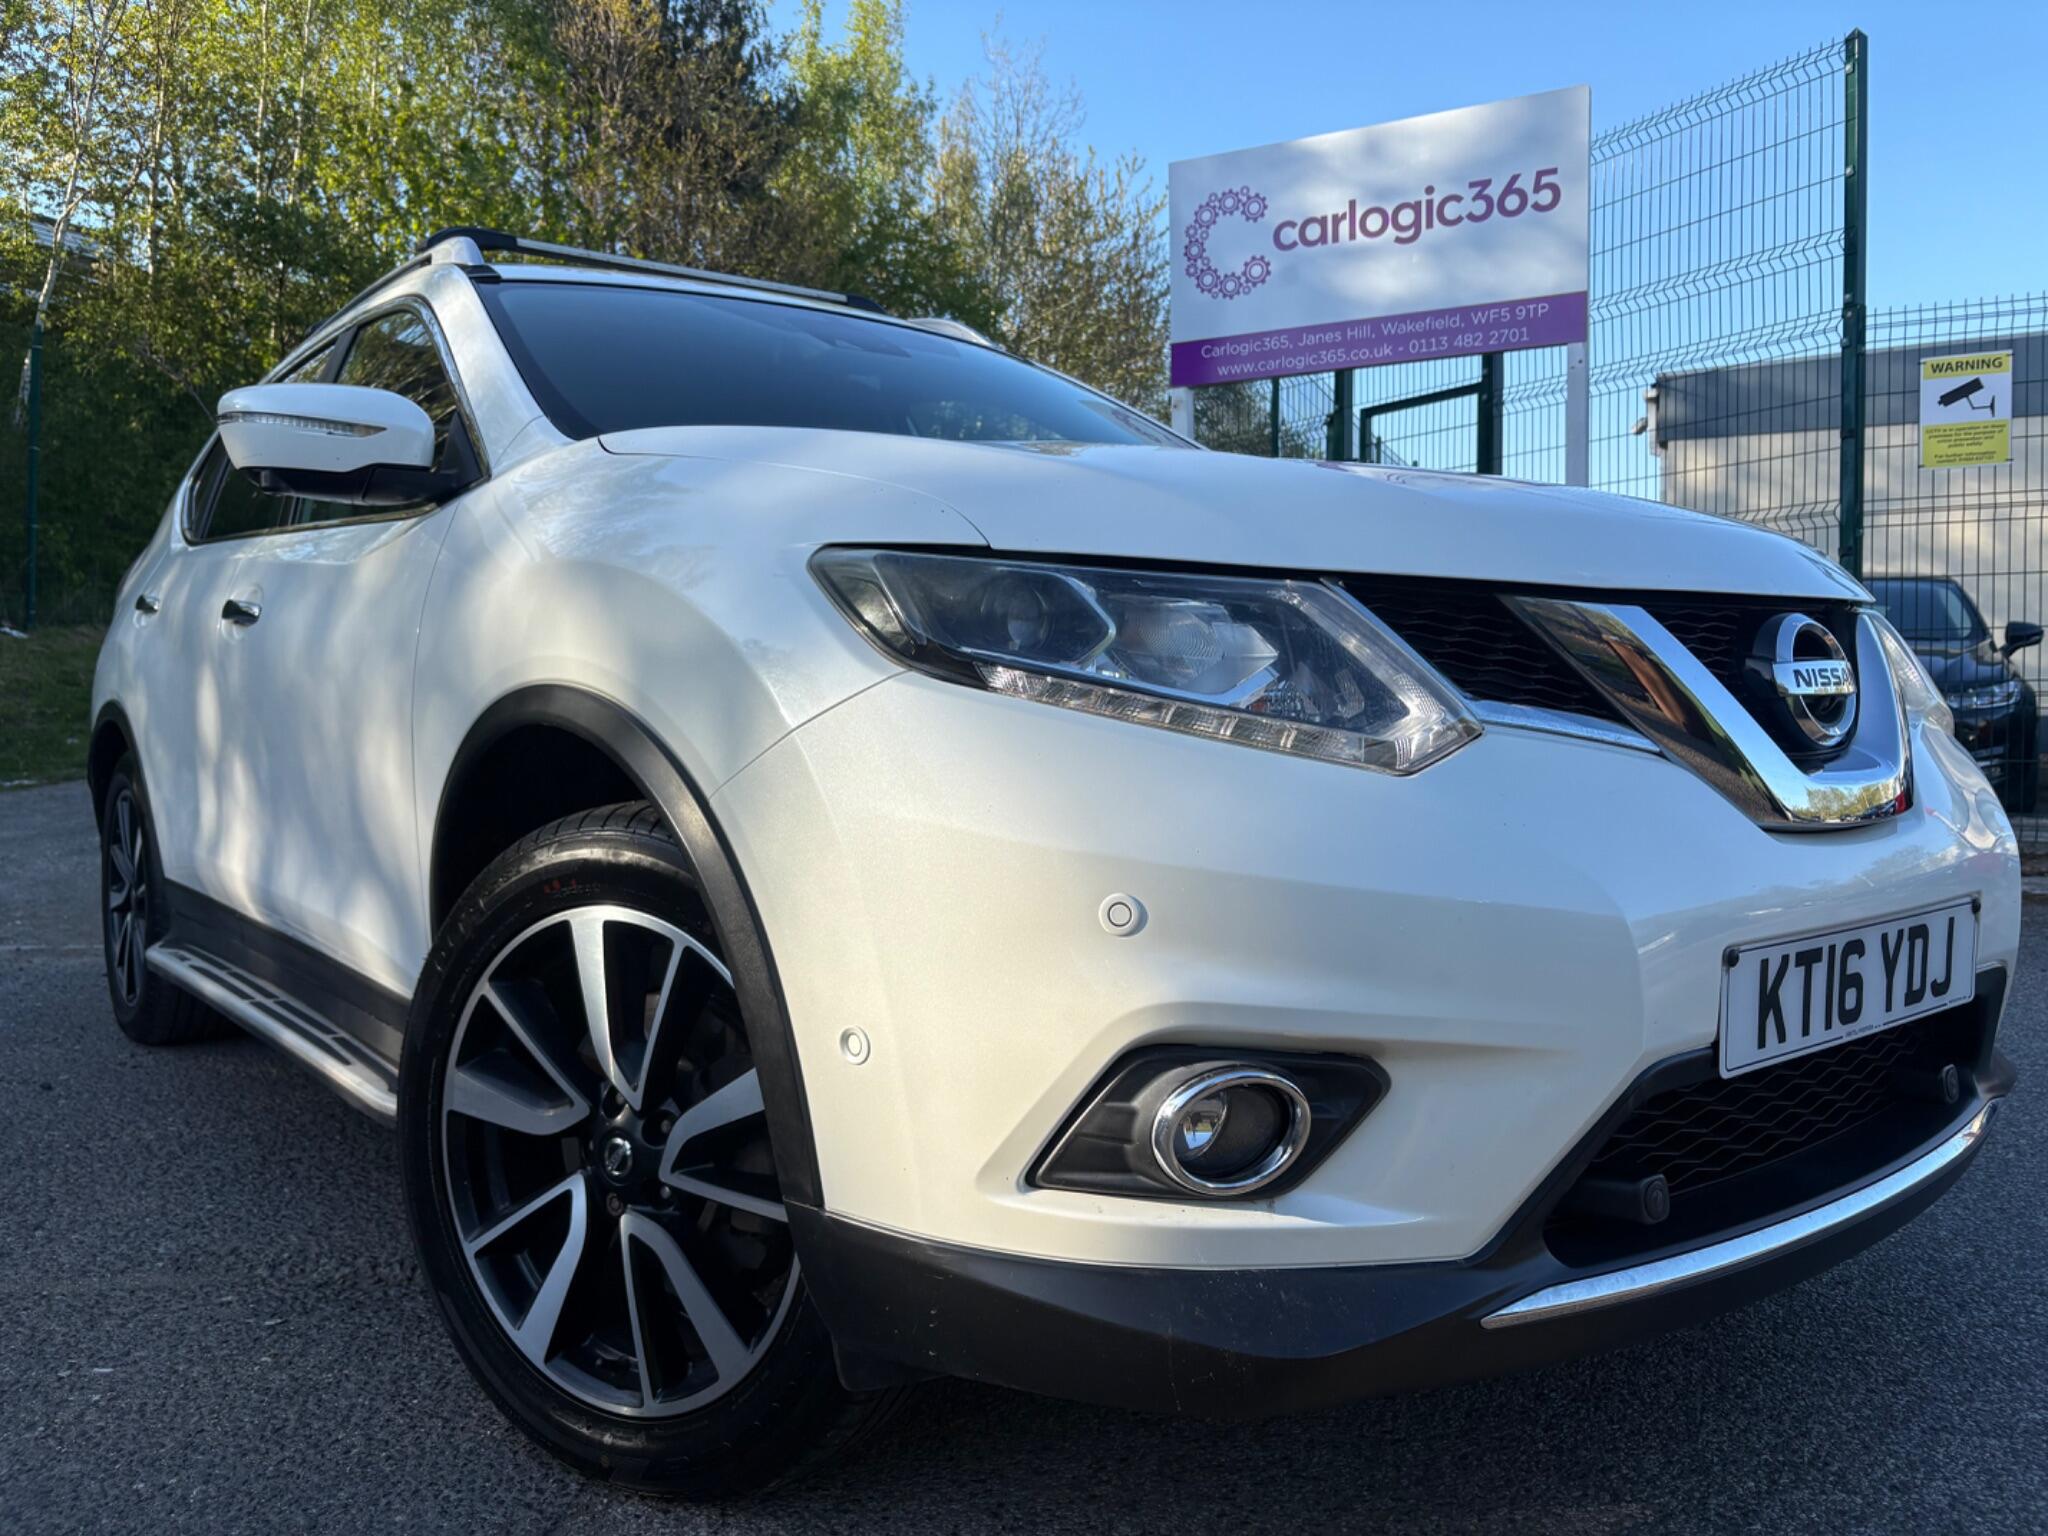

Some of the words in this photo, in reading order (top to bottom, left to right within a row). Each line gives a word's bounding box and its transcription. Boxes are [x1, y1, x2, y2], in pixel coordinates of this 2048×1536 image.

[1272, 166, 1562, 252] carlogic365
[1201, 335, 1294, 359] Carlogic365,
[1298, 329, 1342, 348] Janes
[1347, 324, 1376, 341] Hill,
[1381, 315, 1465, 337] Wakefield,
[1471, 307, 1511, 325] WF5
[1515, 303, 1550, 320] 9TP
[1216, 343, 1393, 377] www.carlogic365.co.uk
[1409, 336, 1448, 354] 0113
[1454, 332, 1484, 349] 482
[1489, 327, 1530, 345] 2701
[1931, 356, 2003, 374] WARNING
[1793, 667, 1853, 688] NISSA
[1757, 938, 1866, 1050] KT16
[1881, 916, 1955, 1013] YDJ
